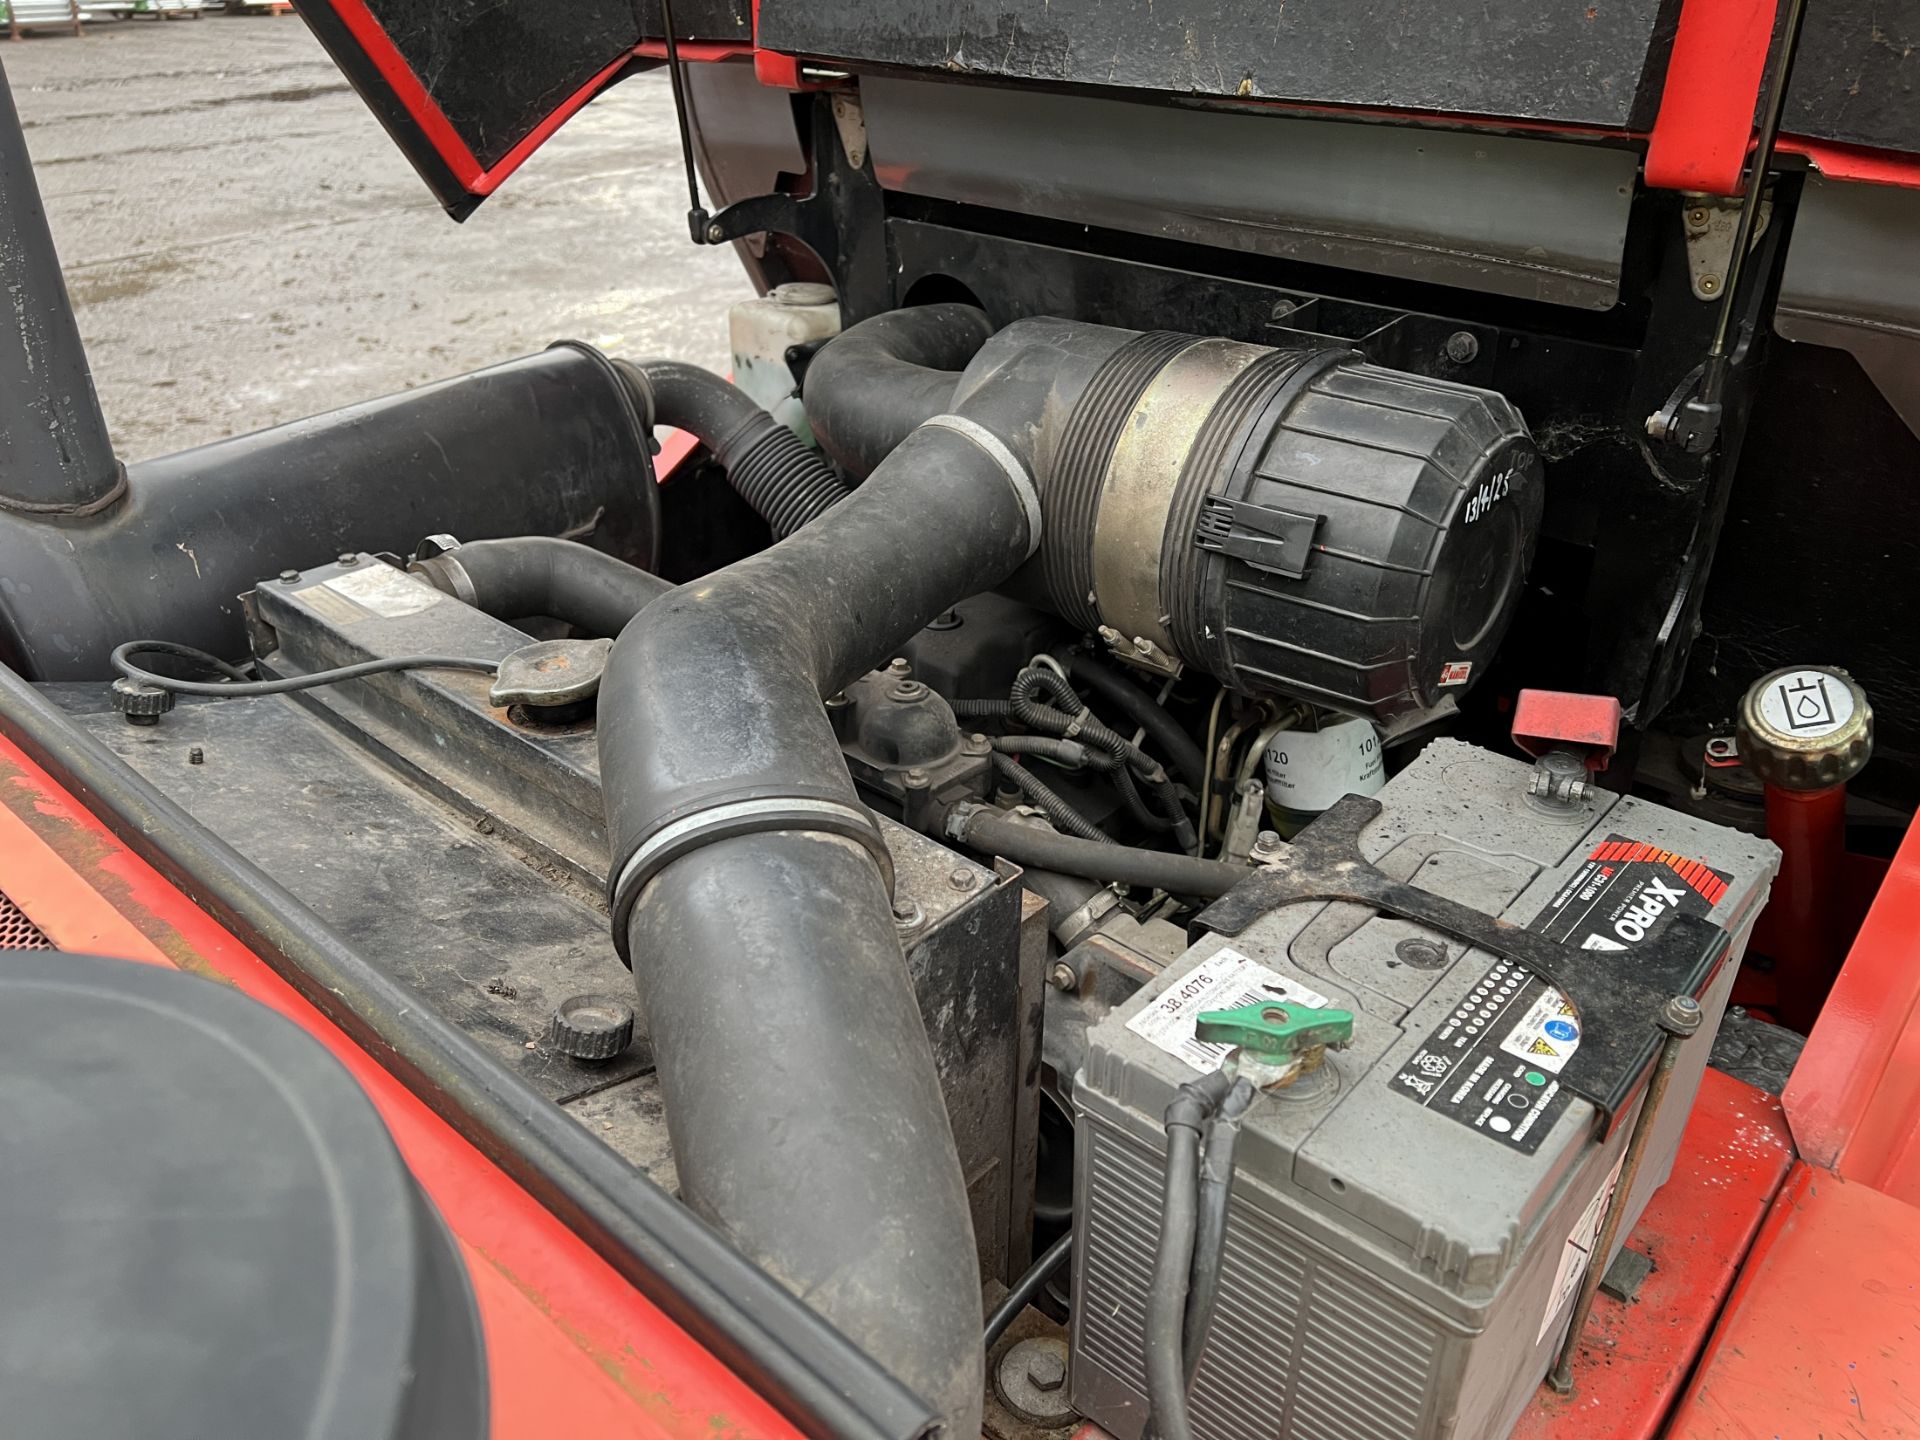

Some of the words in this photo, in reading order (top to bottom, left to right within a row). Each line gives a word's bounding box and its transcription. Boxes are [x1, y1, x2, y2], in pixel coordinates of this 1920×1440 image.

[1464, 467, 1514, 524] 13/4/25
[1609, 903, 1627, 922] POWER
[1475, 1055, 1495, 1075] MADE
[1468, 1072, 1481, 1083] IN
[1450, 1080, 1475, 1104] KOREA
